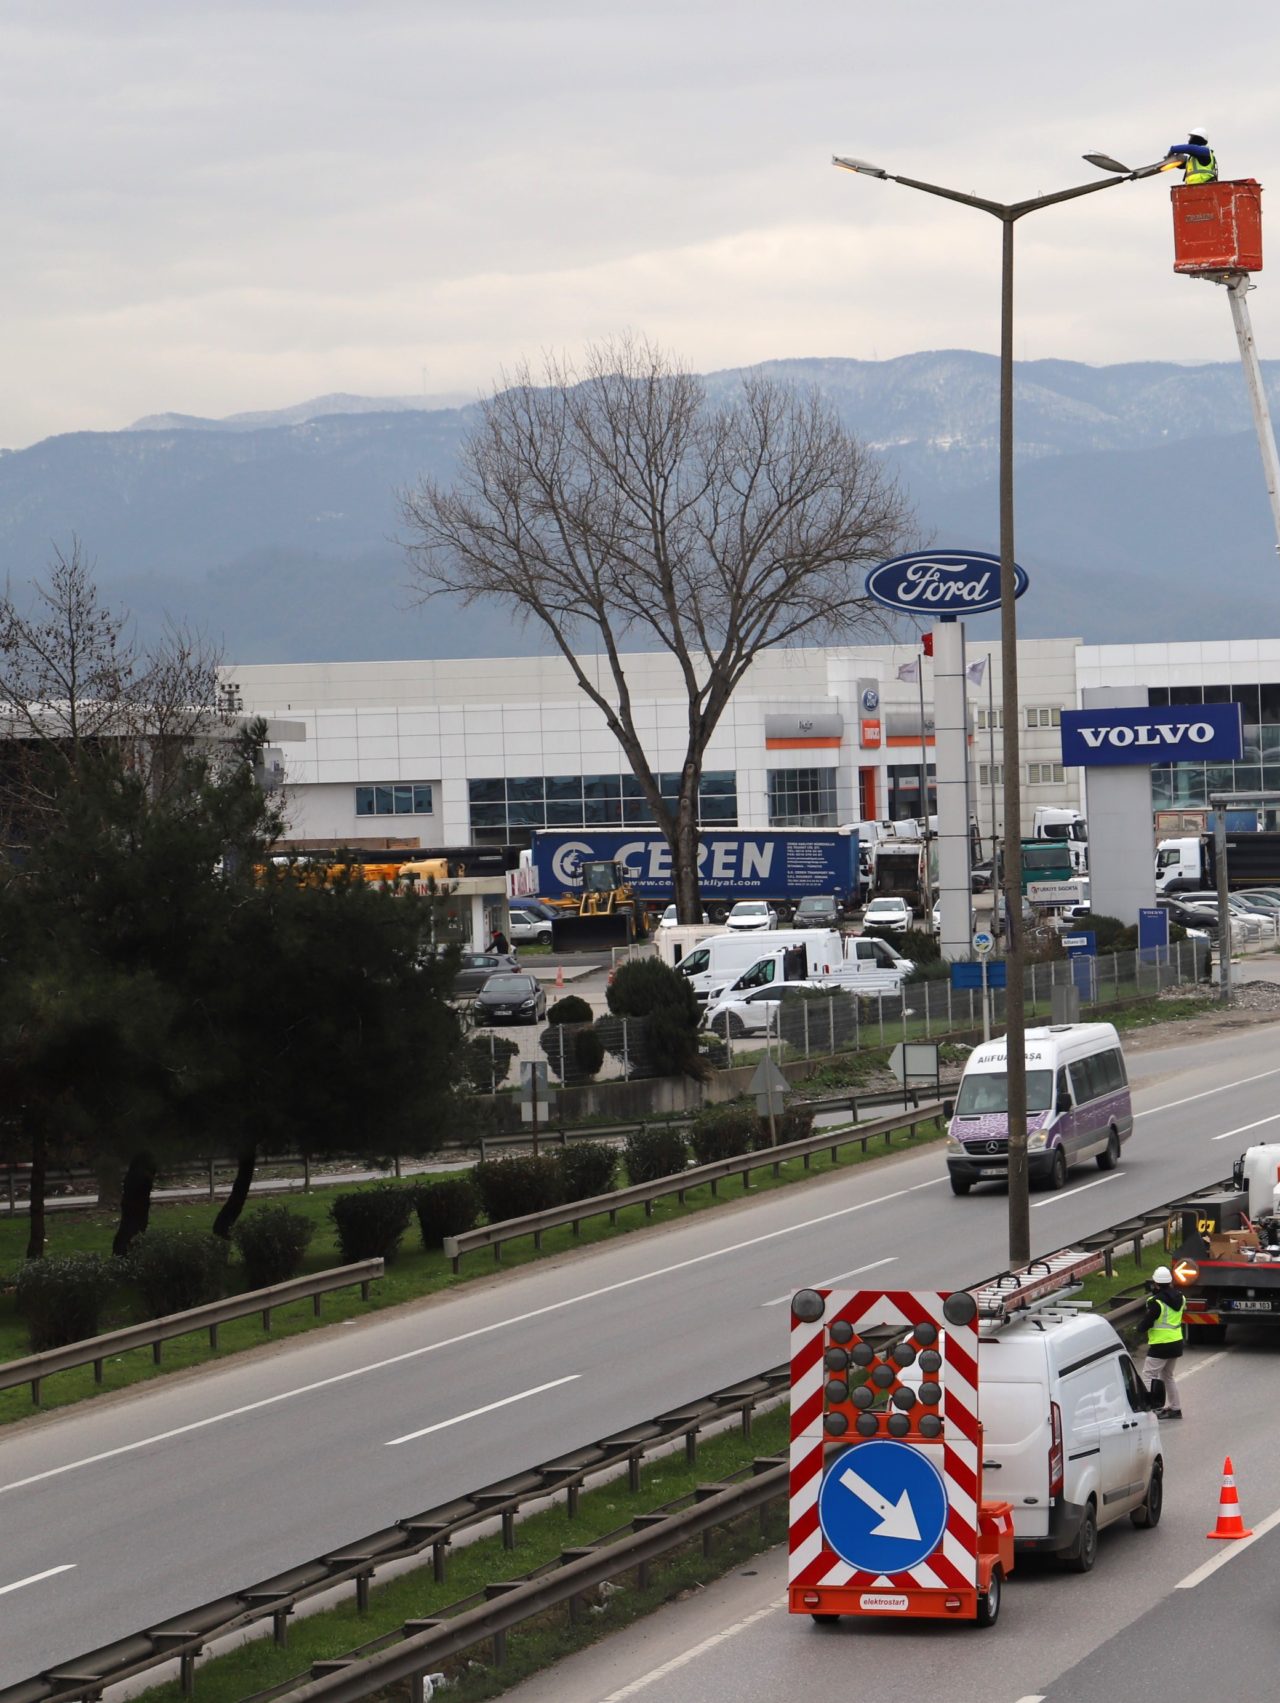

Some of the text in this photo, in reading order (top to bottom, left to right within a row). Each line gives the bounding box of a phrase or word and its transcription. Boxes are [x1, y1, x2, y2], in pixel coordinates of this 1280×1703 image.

[897, 562, 991, 601] Ford
[1077, 722, 1215, 747] VOLVO
[613, 841, 775, 879] CEEN
[863, 1598, 905, 1606] elektrostart
